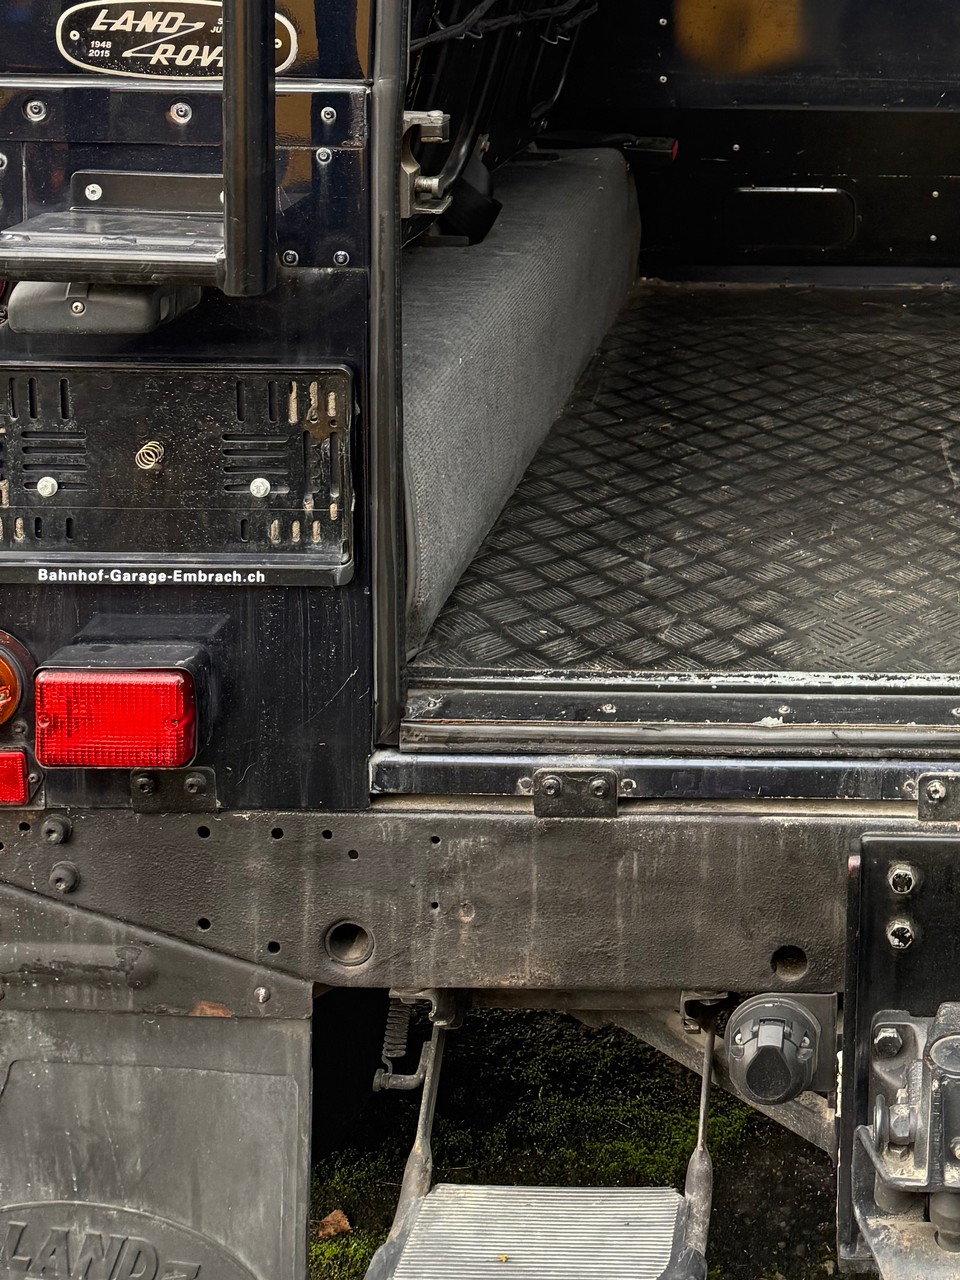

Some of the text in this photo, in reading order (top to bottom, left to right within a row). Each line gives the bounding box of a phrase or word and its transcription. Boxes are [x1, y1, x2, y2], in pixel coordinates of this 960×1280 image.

[90, 9, 187, 34] LAND
[90, 40, 112, 49] 1948
[88, 49, 111, 58] 2015
[149, 44, 223, 67] ROV
[38, 569, 266, 584] Bahnhof-Garage-Embrach.ch
